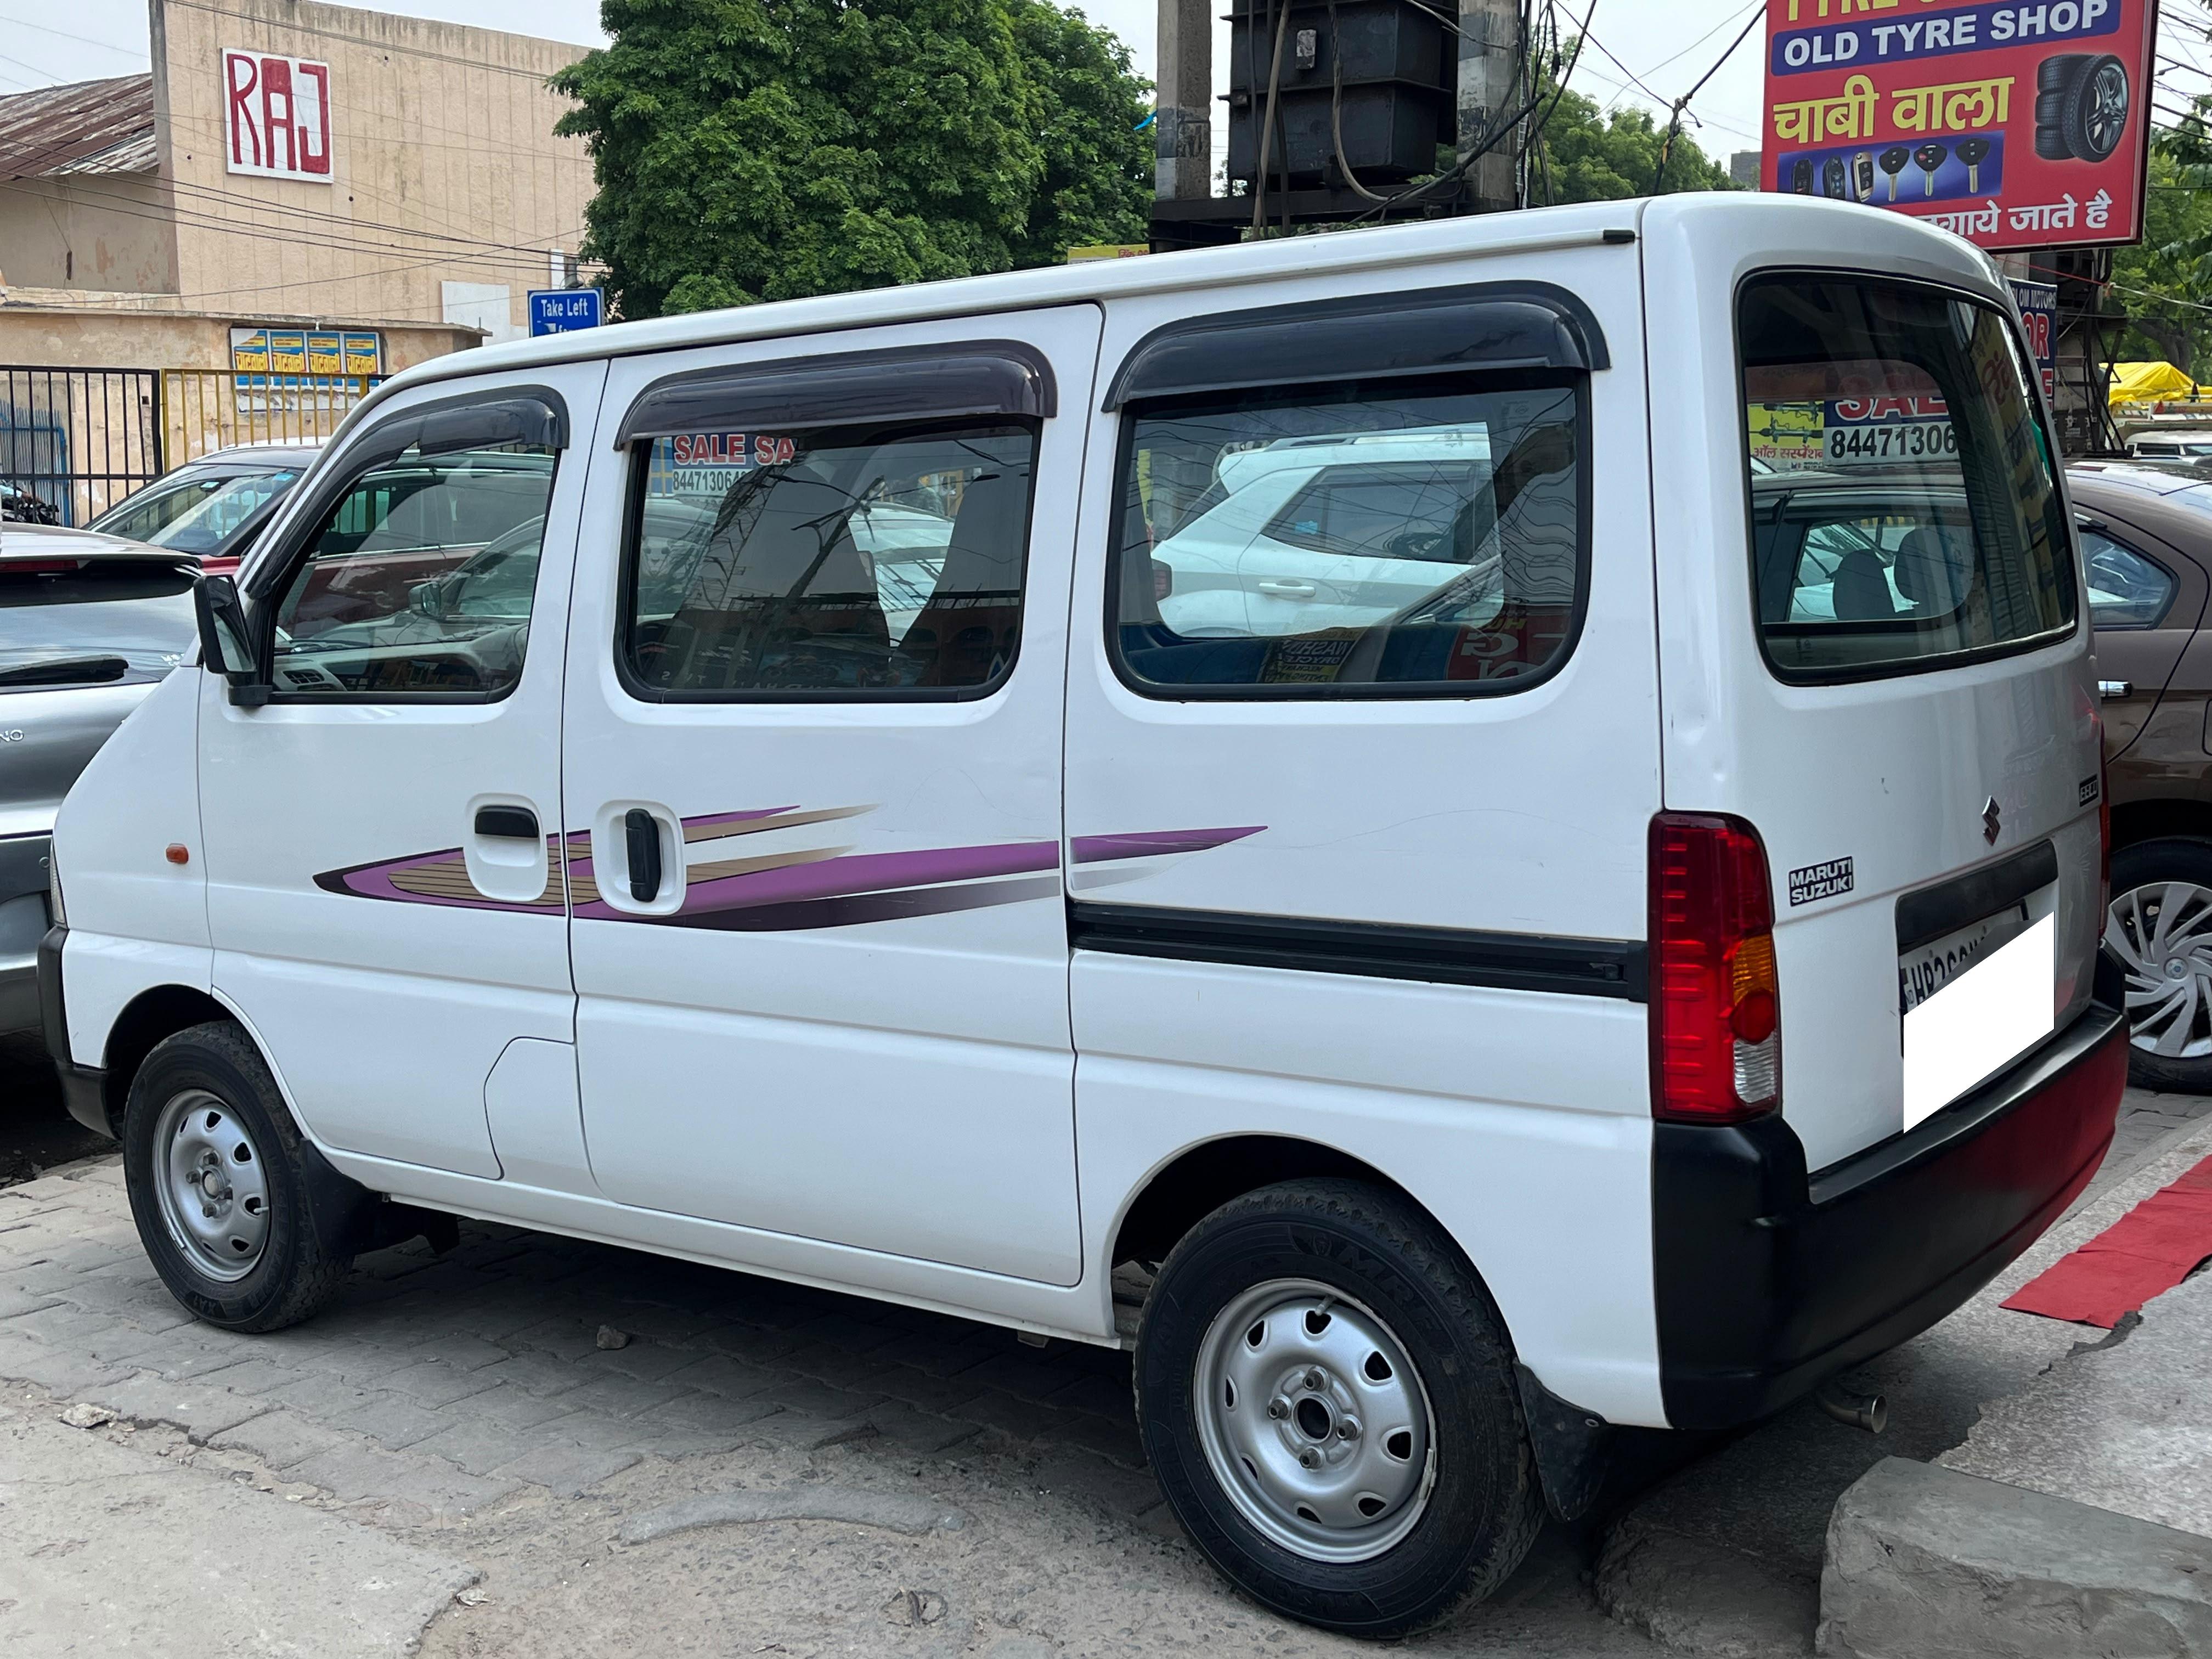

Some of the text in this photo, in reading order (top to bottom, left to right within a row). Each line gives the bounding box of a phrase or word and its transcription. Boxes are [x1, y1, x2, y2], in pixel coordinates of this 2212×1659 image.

[1784, 0, 2108, 67] OLD TYRE SHOP
[227, 53, 330, 174] RAJ
[1773, 74, 2015, 144] चाबी वाला
[2008, 193, 2078, 230] जाते
[2085, 188, 2113, 229] है
[540, 298, 589, 317] Take Left
[2030, 289, 2057, 310] MOTORS
[674, 434, 746, 465] SALE
[673, 471, 746, 491] 84471306
[1790, 859, 1852, 888] MARUTI
[1791, 875, 1852, 904] SUZUKI
